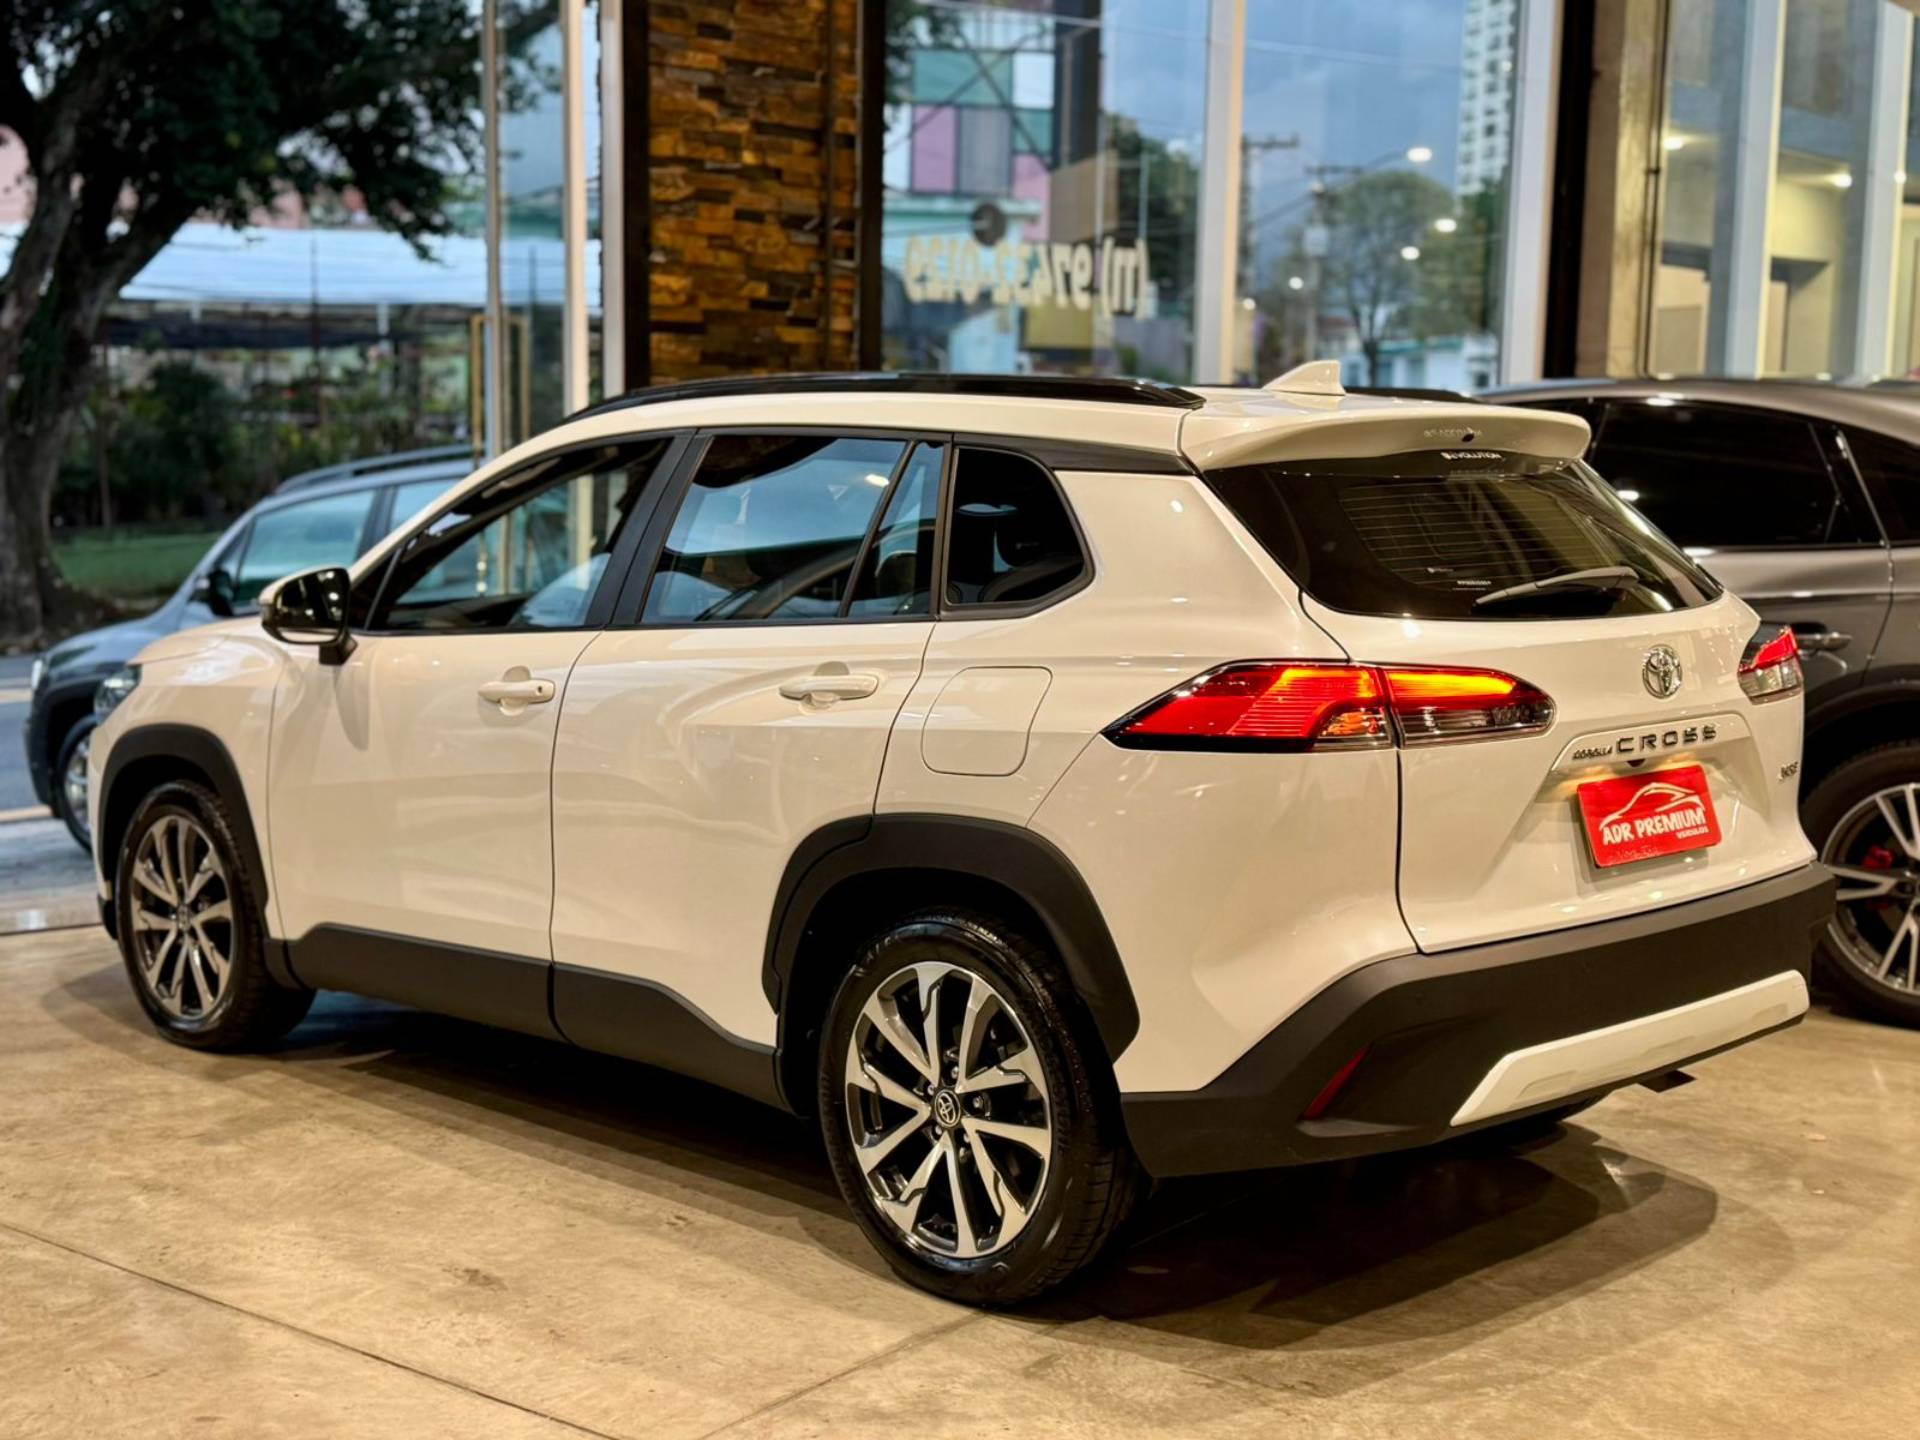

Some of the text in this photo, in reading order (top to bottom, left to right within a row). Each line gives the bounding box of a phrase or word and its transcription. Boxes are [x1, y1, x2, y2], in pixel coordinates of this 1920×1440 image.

[1615, 723, 1718, 754] CROSS
[1602, 807, 1706, 846] ADR PREMIUM
